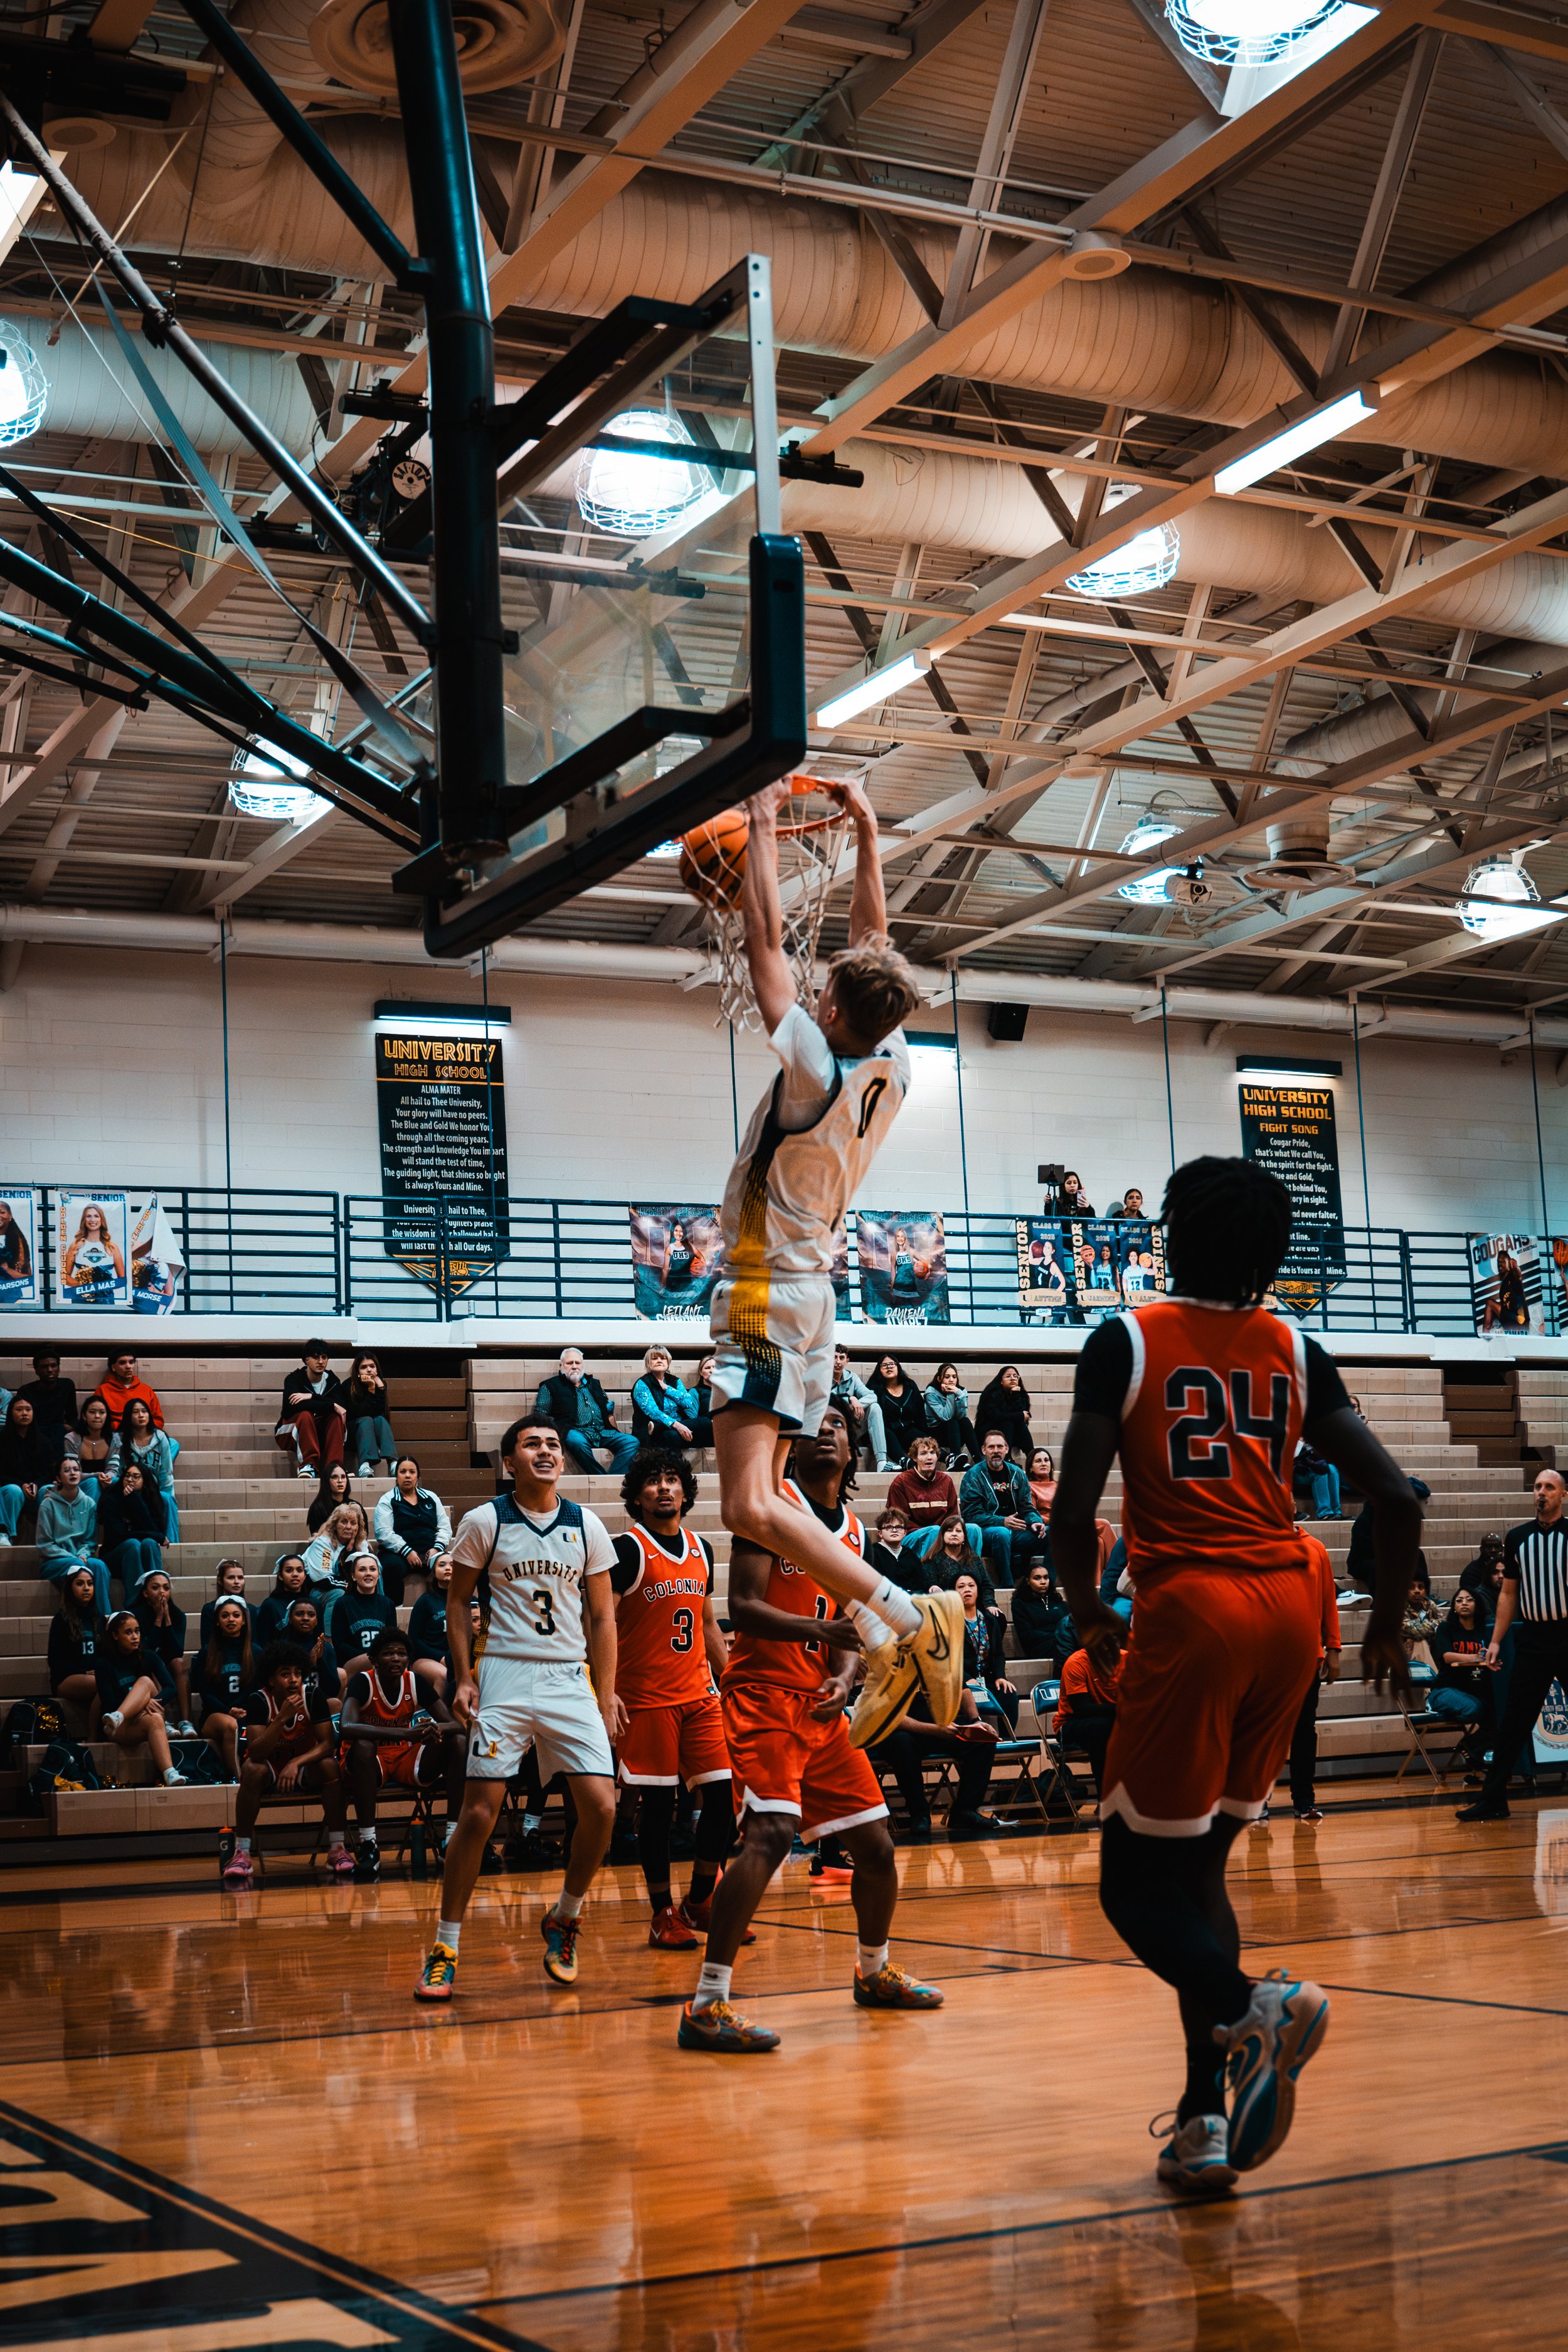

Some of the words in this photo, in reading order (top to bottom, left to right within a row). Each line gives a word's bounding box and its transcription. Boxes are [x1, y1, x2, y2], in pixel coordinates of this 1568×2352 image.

[384, 1040, 495, 1062] UNIVERSITY
[395, 1064, 428, 1076] HIGH
[435, 1066, 487, 1079] SCHOOL
[421, 1085, 438, 1094] ALMA
[440, 1086, 460, 1094] MATER
[1243, 1088, 1329, 1104] UNIVERSITY
[401, 1096, 409, 1104] All
[411, 1097, 423, 1105] hail
[432, 1098, 447, 1106] Thee
[449, 1098, 482, 1108] University,
[396, 1108, 410, 1116] Your
[411, 1109, 428, 1119] glory
[430, 1109, 441, 1118] will
[443, 1110, 457, 1118] have
[468, 1111, 487, 1121] peers.
[1244, 1104, 1276, 1116] HIGH
[1281, 1106, 1332, 1120] SCHOOL
[391, 1120, 403, 1128] The
[405, 1121, 418, 1129] Blue
[420, 1121, 432, 1130] and
[434, 1121, 448, 1130] Gold
[450, 1122, 458, 1130] We
[460, 1122, 479, 1131] honor
[1260, 1123, 1288, 1133] FIGHT
[1291, 1125, 1318, 1134] SONG
[397, 1133, 423, 1143] through
[434, 1133, 445, 1142] the
[446, 1134, 469, 1144] coming
[470, 1135, 489, 1144] years.
[1270, 1138, 1291, 1148] Cougar
[1293, 1139, 1310, 1148] Pride,
[383, 1144, 393, 1152] The
[395, 1145, 421, 1155] strength
[437, 1146, 469, 1155] knowledge
[1313, 1152, 1325, 1160] You,
[403, 1157, 414, 1165] will
[416, 1157, 433, 1165] stand
[435, 1157, 446, 1166] the
[447, 1158, 458, 1167] test
[460, 1158, 467, 1167] of
[468, 1159, 485, 1168] time,
[1279, 1161, 1295, 1170] spirit
[1296, 1161, 1305, 1169] for
[1316, 1163, 1334, 1172] fight.
[384, 1168, 395, 1176] The
[396, 1168, 421, 1179] guiding
[423, 1169, 440, 1179] light,
[442, 1170, 453, 1178] that
[456, 1170, 475, 1179] shines
[1298, 1173, 1313, 1182] Gold,
[412, 1182, 434, 1191] always
[466, 1183, 484, 1191] Mine.
[1293, 1184, 1313, 1192] behind
[1314, 1185, 1327, 1194] You,
[91, 1194, 125, 1202] SENIOR
[1310, 1196, 1328, 1205] sight.
[448, 1205, 460, 1214] hail
[469, 1206, 487, 1216] Thee,
[1318, 1210, 1338, 1220] falter,
[392, 1229, 403, 1237] the
[404, 1229, 430, 1237] wisdom
[464, 1242, 475, 1251] Our
[476, 1242, 492, 1253] days.
[897, 1256, 912, 1264] UHS
[1016, 1221, 1030, 1289] SENIOR
[1071, 1223, 1086, 1290] SENIOR
[76, 1285, 95, 1294] ELLA
[98, 1281, 115, 1290] MAS
[137, 1291, 162, 1302] MORSE
[1164, 1366, 1291, 1486] 24
[502, 1560, 578, 1582] UNIVERSITY
[532, 1589, 556, 1636] 3
[671, 1608, 694, 1653] 3
[82, 1641, 94, 1655] 13
[229, 1675, 240, 1693] 2
